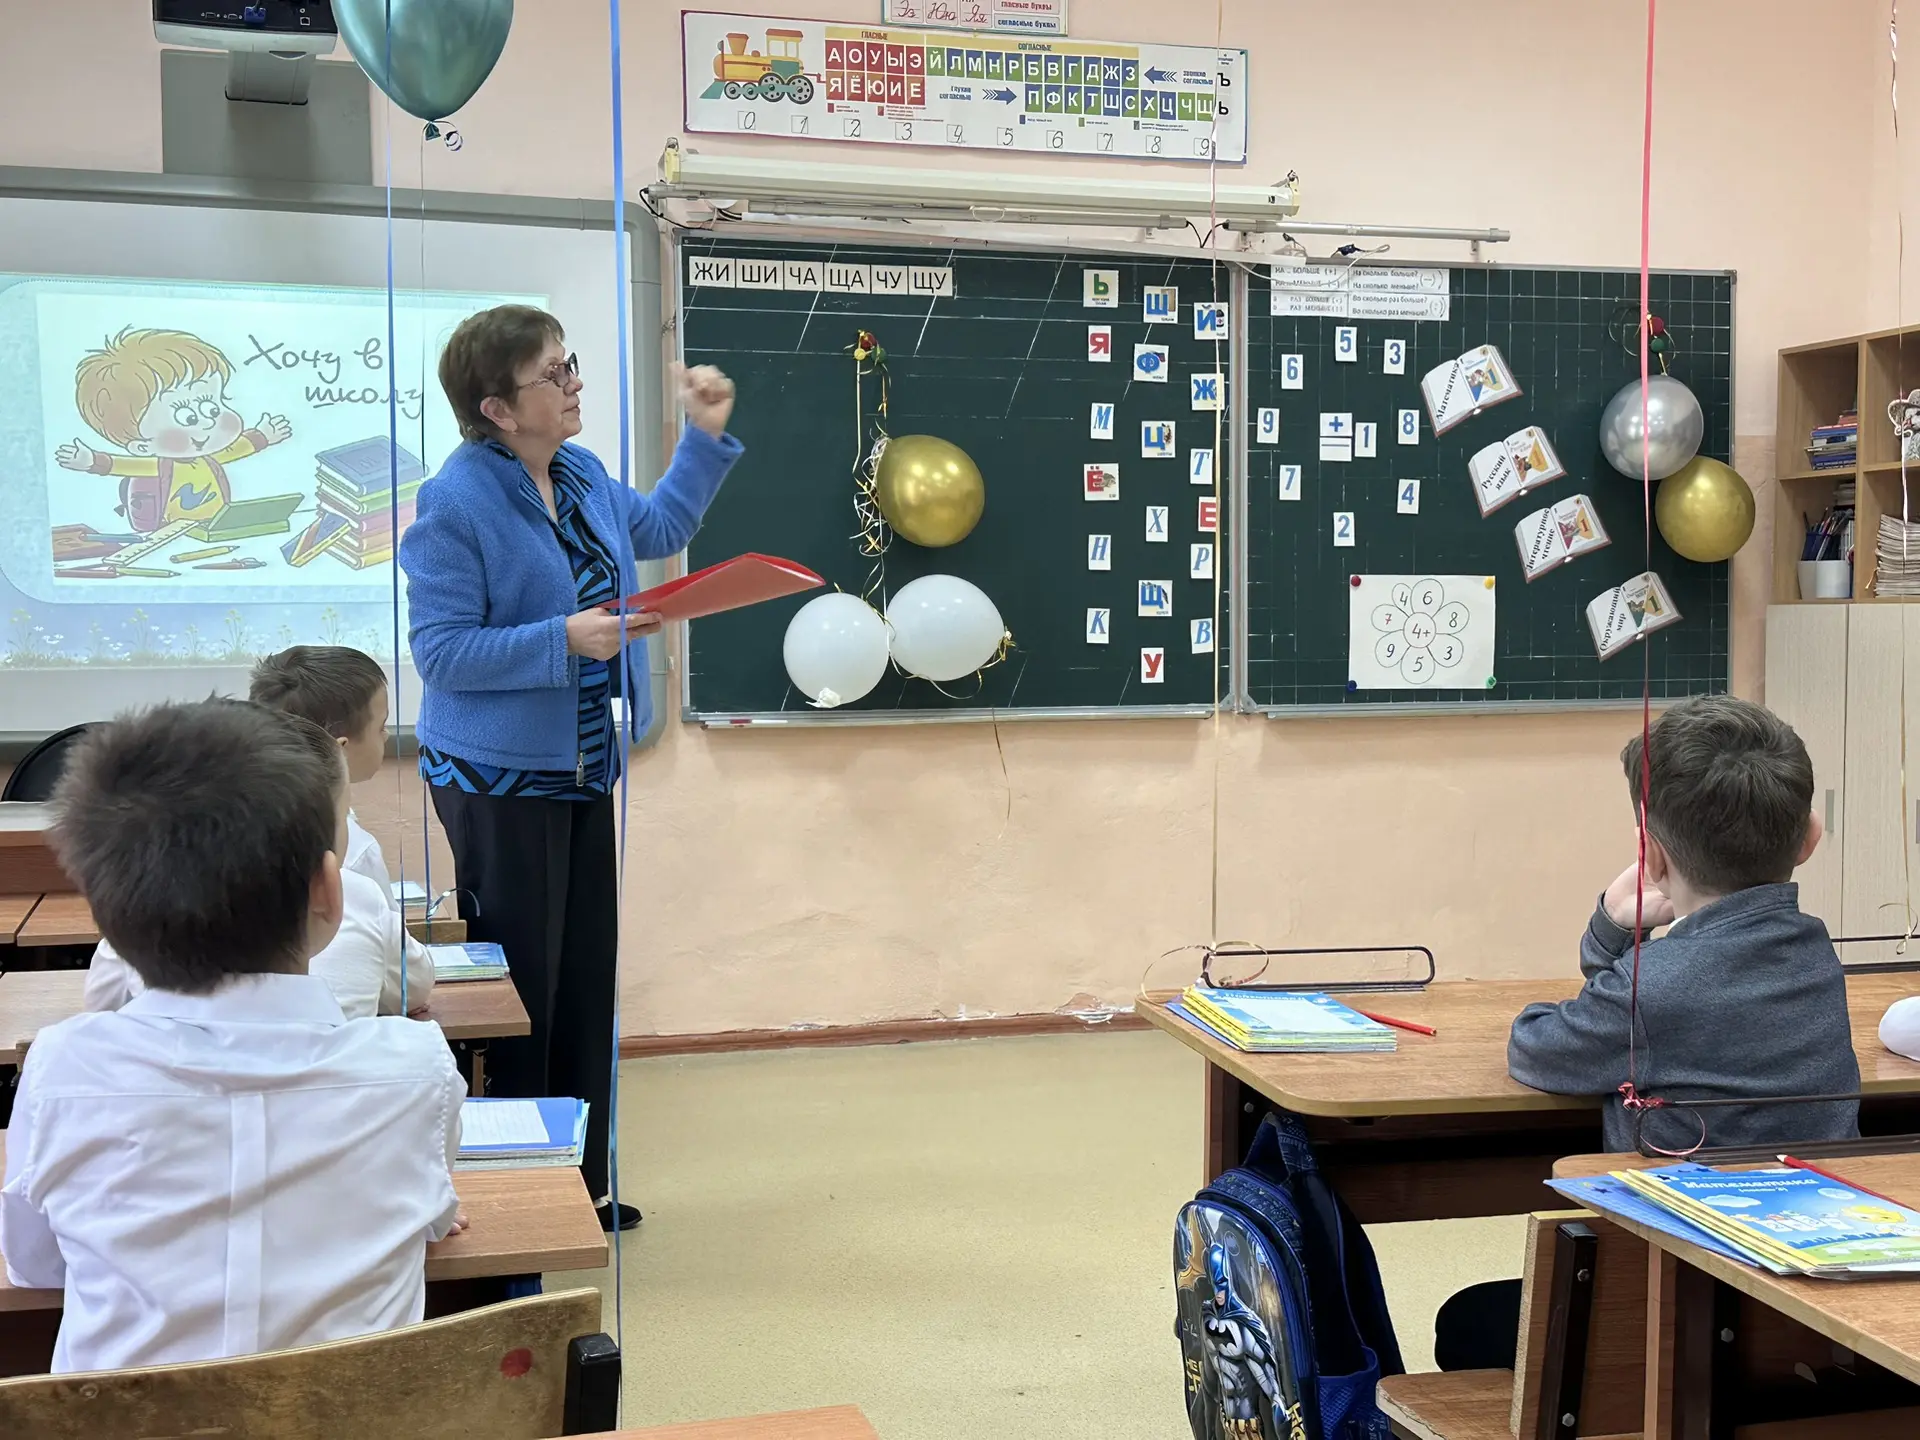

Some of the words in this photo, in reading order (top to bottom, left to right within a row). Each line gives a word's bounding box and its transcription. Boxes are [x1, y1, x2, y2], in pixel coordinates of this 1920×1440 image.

[828, 48, 842, 62] А
[849, 49, 862, 63] О
[870, 50, 882, 64] У
[887, 51, 903, 66] Ы
[910, 53, 922, 67] Э
[930, 51, 942, 69] Й
[950, 56, 961, 71] Л
[969, 57, 982, 71] М
[989, 59, 1000, 73] Н
[1009, 60, 1020, 74] Р
[1028, 61, 1039, 76] Б
[1048, 62, 1059, 76] В
[1068, 63, 1078, 77] Г
[1086, 64, 1099, 81] Д
[1104, 65, 1119, 80] Ж
[1125, 66, 1136, 81] З
[829, 78, 842, 93] Я
[851, 75, 861, 94] Ё
[868, 80, 884, 95] Ю
[890, 82, 902, 96] И
[911, 83, 921, 98] Е
[1028, 90, 1039, 105] П
[1047, 91, 1061, 106] Ф
[1068, 92, 1078, 106] К
[1087, 93, 1098, 107] Т
[1104, 94, 1119, 109] Ш
[1125, 95, 1136, 110] С
[1144, 96, 1155, 111] Х
[1162, 98, 1173, 116] Ц
[1182, 98, 1192, 113] Ч
[1198, 99, 1213, 116] Щ
[744, 112, 755, 129] 0
[800, 117, 808, 133] 1
[850, 119, 861, 137] 2
[902, 122, 912, 140] 3
[953, 125, 963, 143] 4
[1003, 128, 1013, 145] 5
[1052, 131, 1063, 148] 6
[1103, 133, 1113, 151] 7
[1151, 136, 1161, 153] 8
[1200, 138, 1209, 156] 9
[694, 262, 729, 282] ЖИ
[742, 264, 777, 284] ШИ
[790, 267, 817, 285] ЧА
[830, 268, 865, 291] ЩА
[877, 271, 901, 288] ЧУ
[914, 272, 947, 293] ЩУ
[1090, 333, 1109, 354] Я
[1340, 330, 1352, 353] 5
[244, 334, 341, 384] Хочу
[354, 337, 383, 370] в
[1137, 352, 1161, 373] Ф
[1389, 343, 1401, 365] 3
[1287, 357, 1297, 380] 6
[1193, 379, 1217, 400] Ж
[305, 386, 423, 420] школу
[1093, 405, 1112, 430] М
[1263, 411, 1273, 433] 9
[1403, 412, 1414, 435] 8
[1144, 426, 1165, 450] Ц
[1363, 425, 1369, 449] 1
[1194, 452, 1210, 475] Т
[1285, 468, 1296, 490] 7
[1402, 483, 1414, 505] 4
[1148, 508, 1166, 533] Х
[1338, 515, 1350, 537] 2
[1091, 537, 1109, 561] Н
[1193, 547, 1210, 571] Р
[1400, 591, 1408, 606] 4
[1422, 590, 1433, 605] 6
[1090, 611, 1107, 634] К
[1384, 613, 1392, 625] 7
[1449, 611, 1459, 628] 8
[1194, 620, 1211, 645] В
[1386, 643, 1395, 658] 9
[1443, 645, 1453, 660] 3
[1143, 654, 1162, 678] У
[1413, 656, 1424, 672] 5
